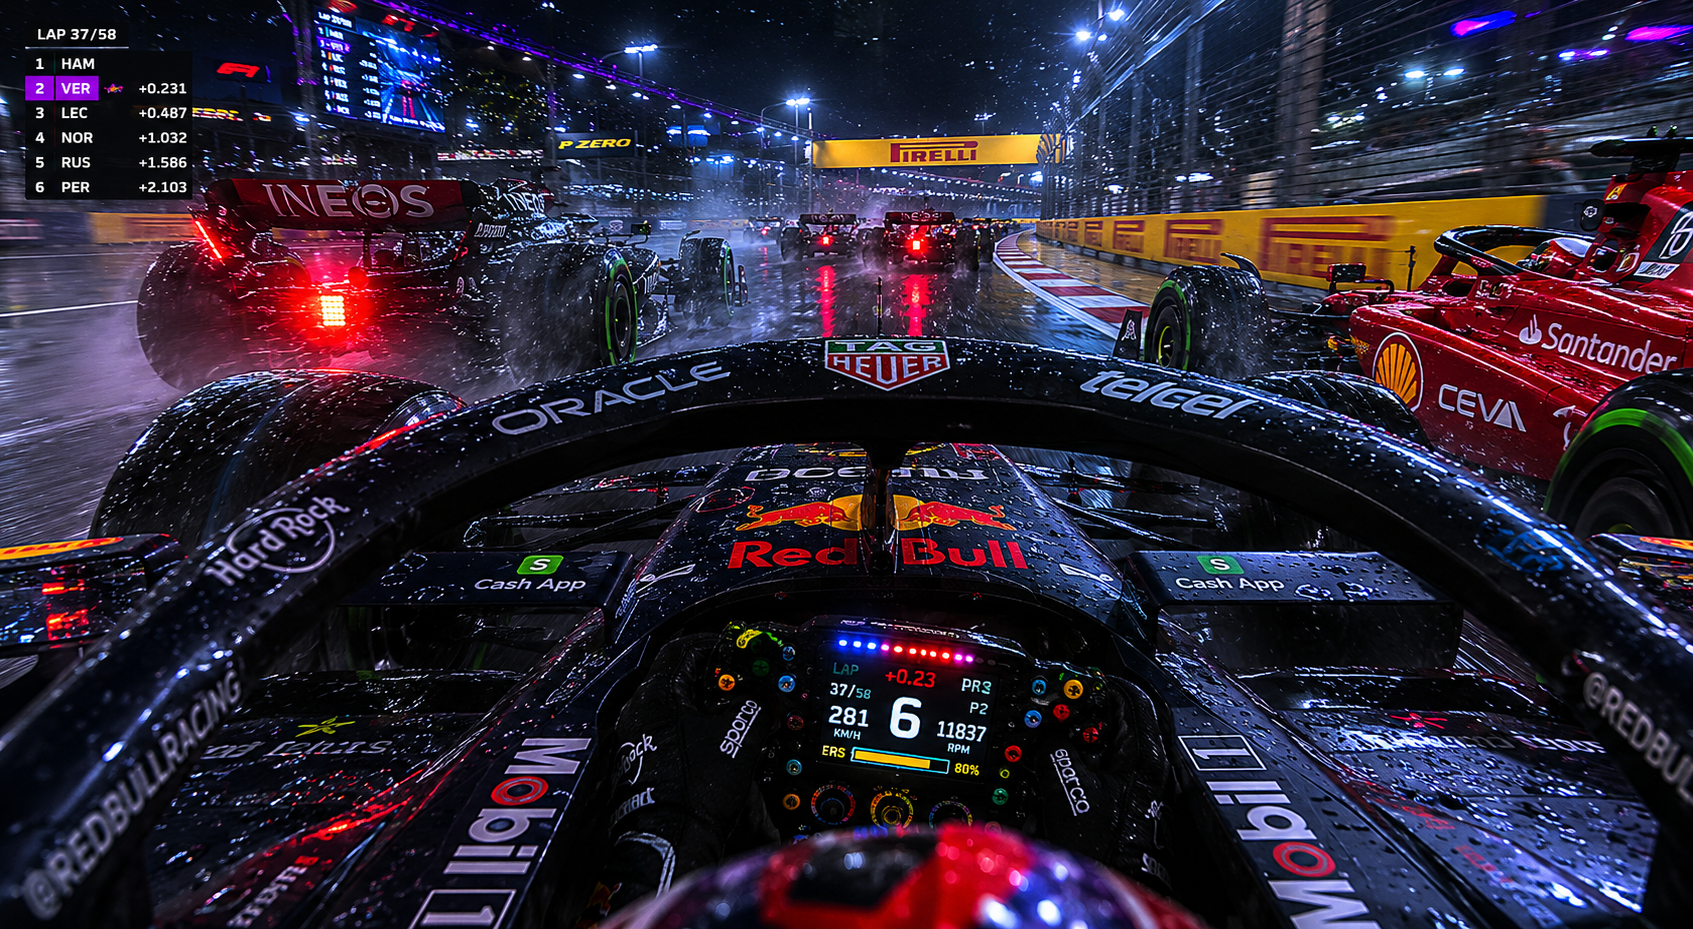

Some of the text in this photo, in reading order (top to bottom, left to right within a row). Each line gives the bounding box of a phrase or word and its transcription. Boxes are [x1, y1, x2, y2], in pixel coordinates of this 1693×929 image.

[558, 138, 632, 150] P ZERO
[889, 140, 979, 163] PIRELLI
[262, 183, 435, 219] INEOS
[834, 341, 937, 352] TAG
[1541, 322, 1678, 374] Santander
[833, 355, 942, 385] HEUER
[491, 360, 731, 436] ORACLE
[1079, 369, 1259, 420] telcel
[1438, 383, 1527, 433] CEVA
[203, 496, 351, 587] Hard Rock
[727, 537, 1028, 570] Red Bull
[474, 578, 587, 592] Cash App
[1175, 577, 1285, 592] Cash App
[832, 661, 860, 676] LAP
[884, 668, 936, 688] +0.23
[829, 682, 872, 700] 37/58
[828, 705, 869, 728] 281
[889, 696, 922, 739] 6
[969, 701, 989, 715] P2
[719, 699, 759, 756] sparco
[833, 728, 861, 741] KM/H
[936, 720, 987, 743] 11837
[822, 745, 980, 776] ERS 80%
[947, 742, 970, 755] RPM
[22, 669, 242, 921] @REDBULLRACING
[1054, 748, 1090, 814] sparco
[419, 737, 592, 927] Mobil 1
[1191, 747, 1383, 929] Mobil 1
